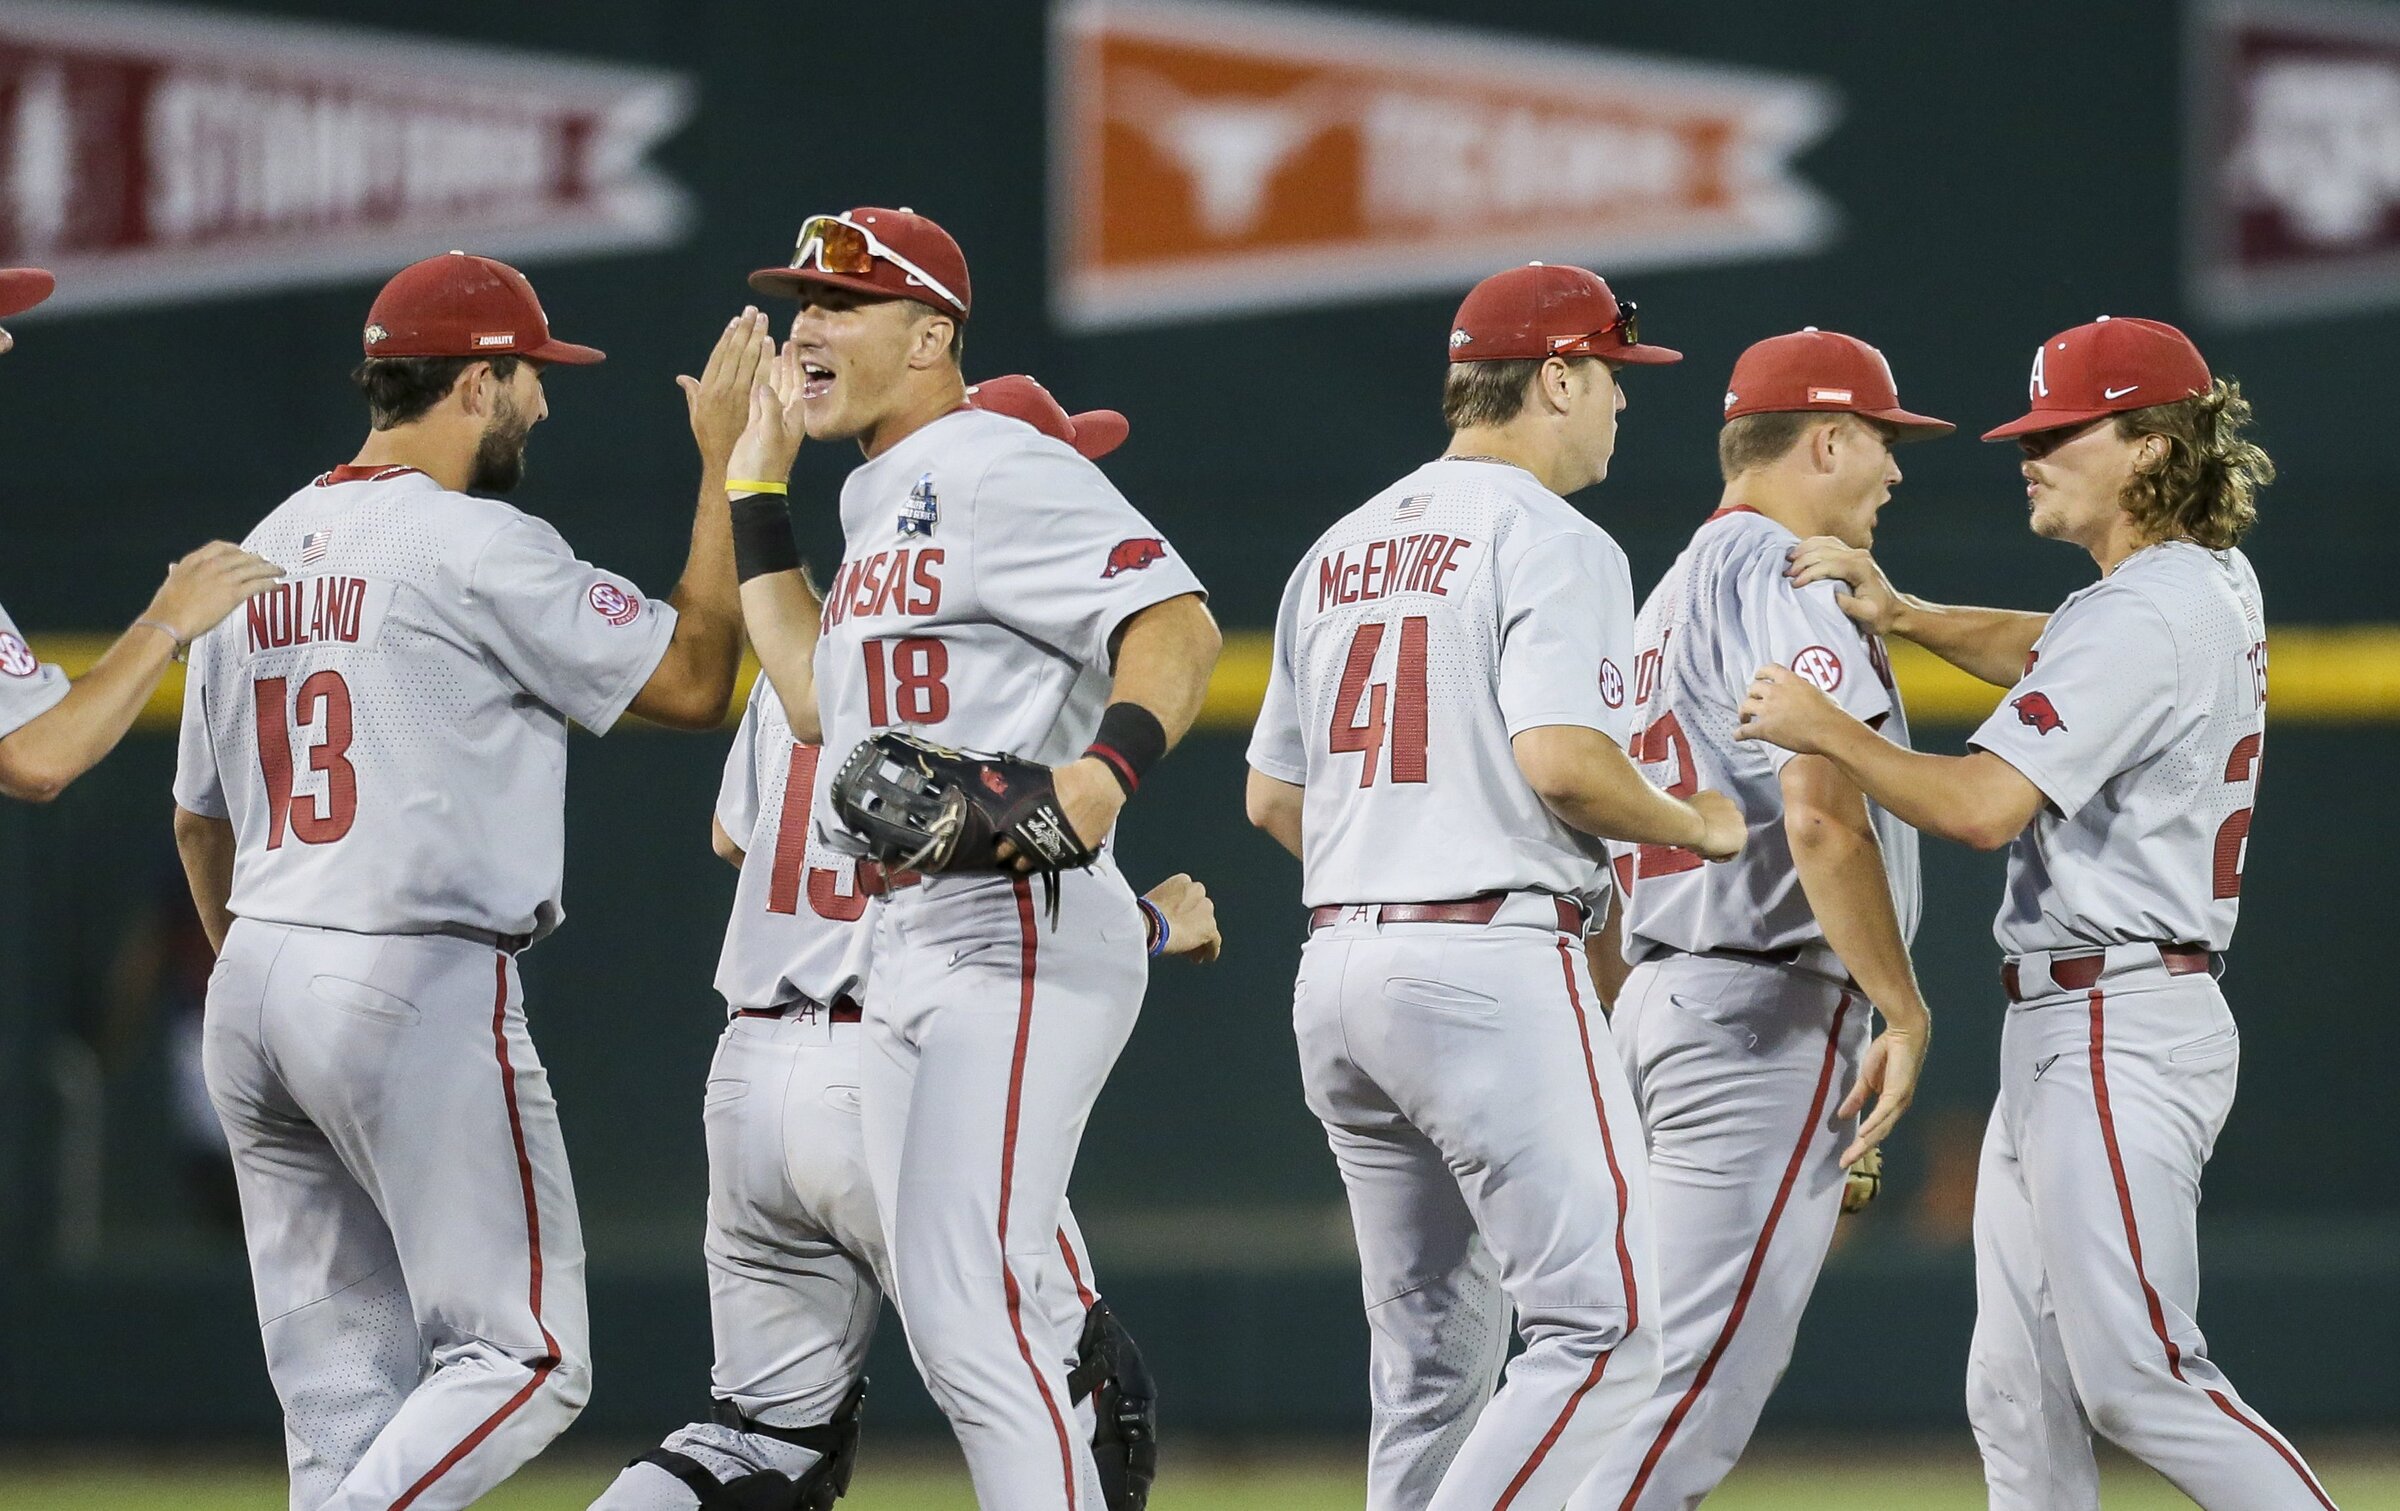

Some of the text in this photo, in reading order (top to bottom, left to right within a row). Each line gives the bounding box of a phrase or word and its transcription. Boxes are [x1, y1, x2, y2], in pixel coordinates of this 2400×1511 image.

[2029, 346, 2049, 400] A
[247, 576, 367, 654] NOLAND
[863, 637, 949, 727] 18
[1329, 616, 1428, 788] 41
[255, 669, 358, 851] 13
